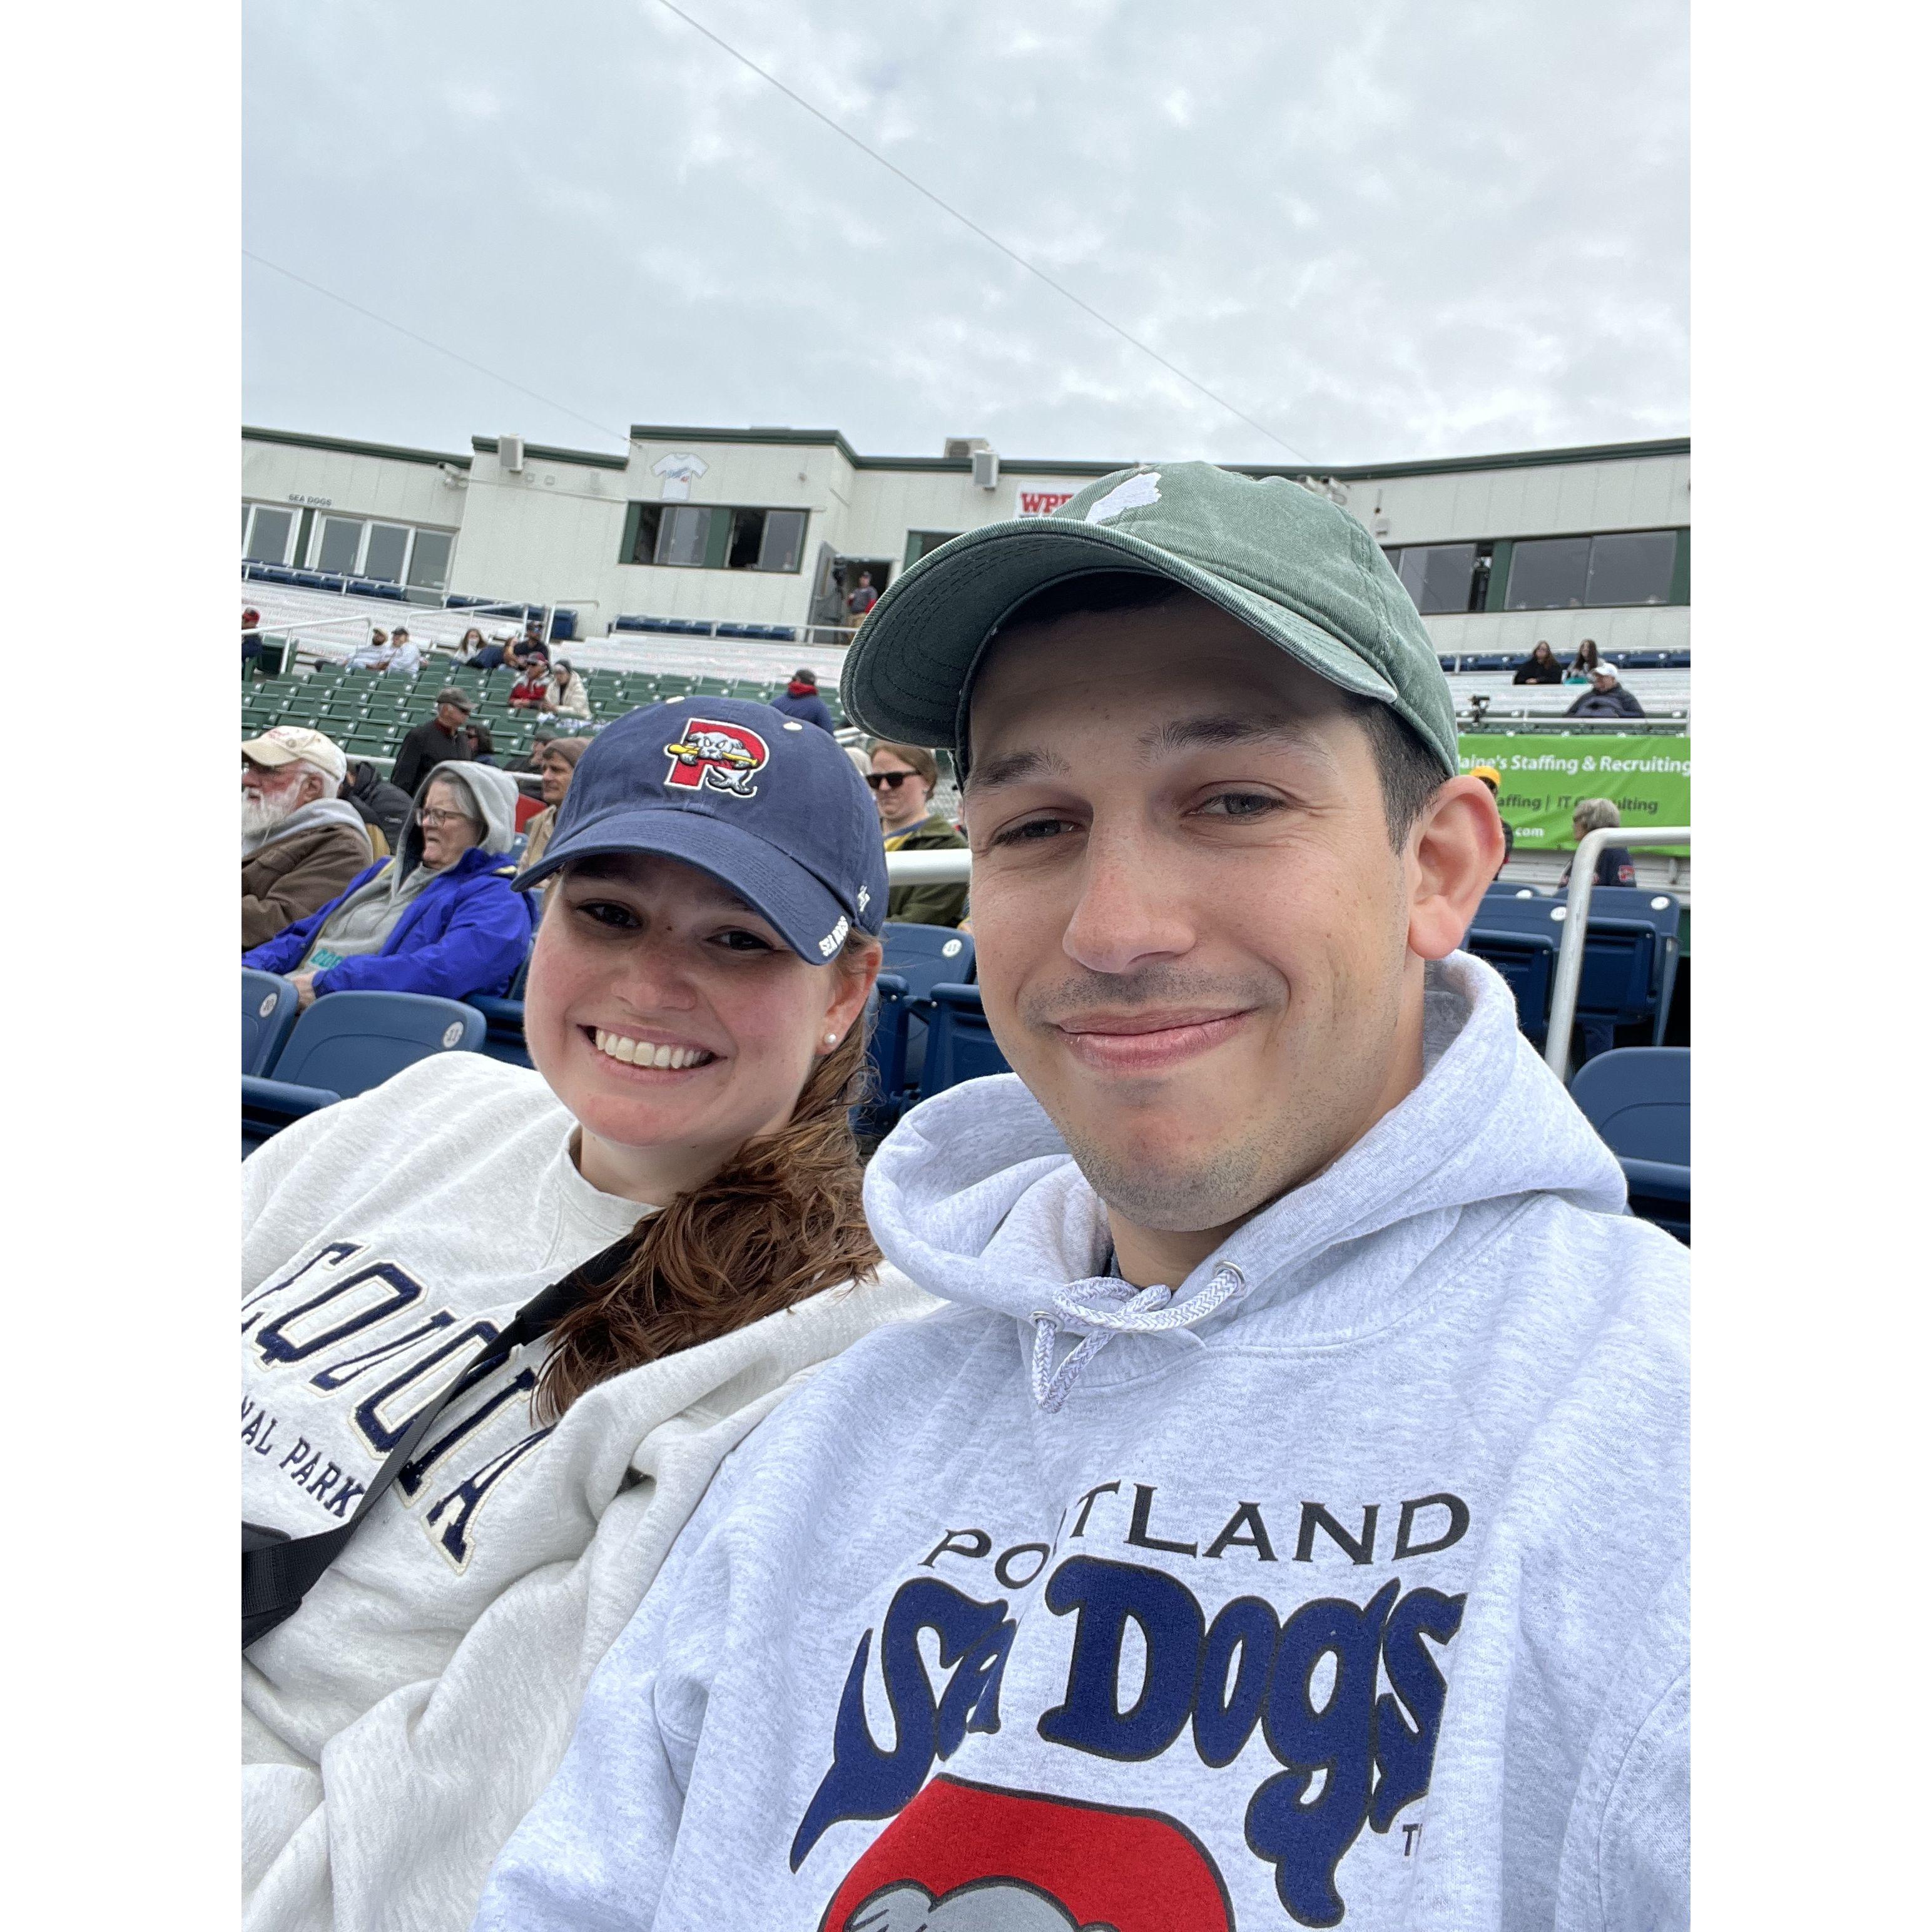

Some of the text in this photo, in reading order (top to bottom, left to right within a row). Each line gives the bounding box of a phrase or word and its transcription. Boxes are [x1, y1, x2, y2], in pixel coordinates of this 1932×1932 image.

[307, 496, 332, 506] DOGS
[1457, 754, 1690, 776] aine's Staffing & Recruiting
[1497, 794, 1542, 811] affing
[1557, 795, 1572, 808] IT
[819, 915, 849, 957] SEA DOGS
[278, 1436, 365, 1518] PARK
[917, 1480, 1470, 1590] POTLAND
[1402, 1823, 1423, 1857] T
